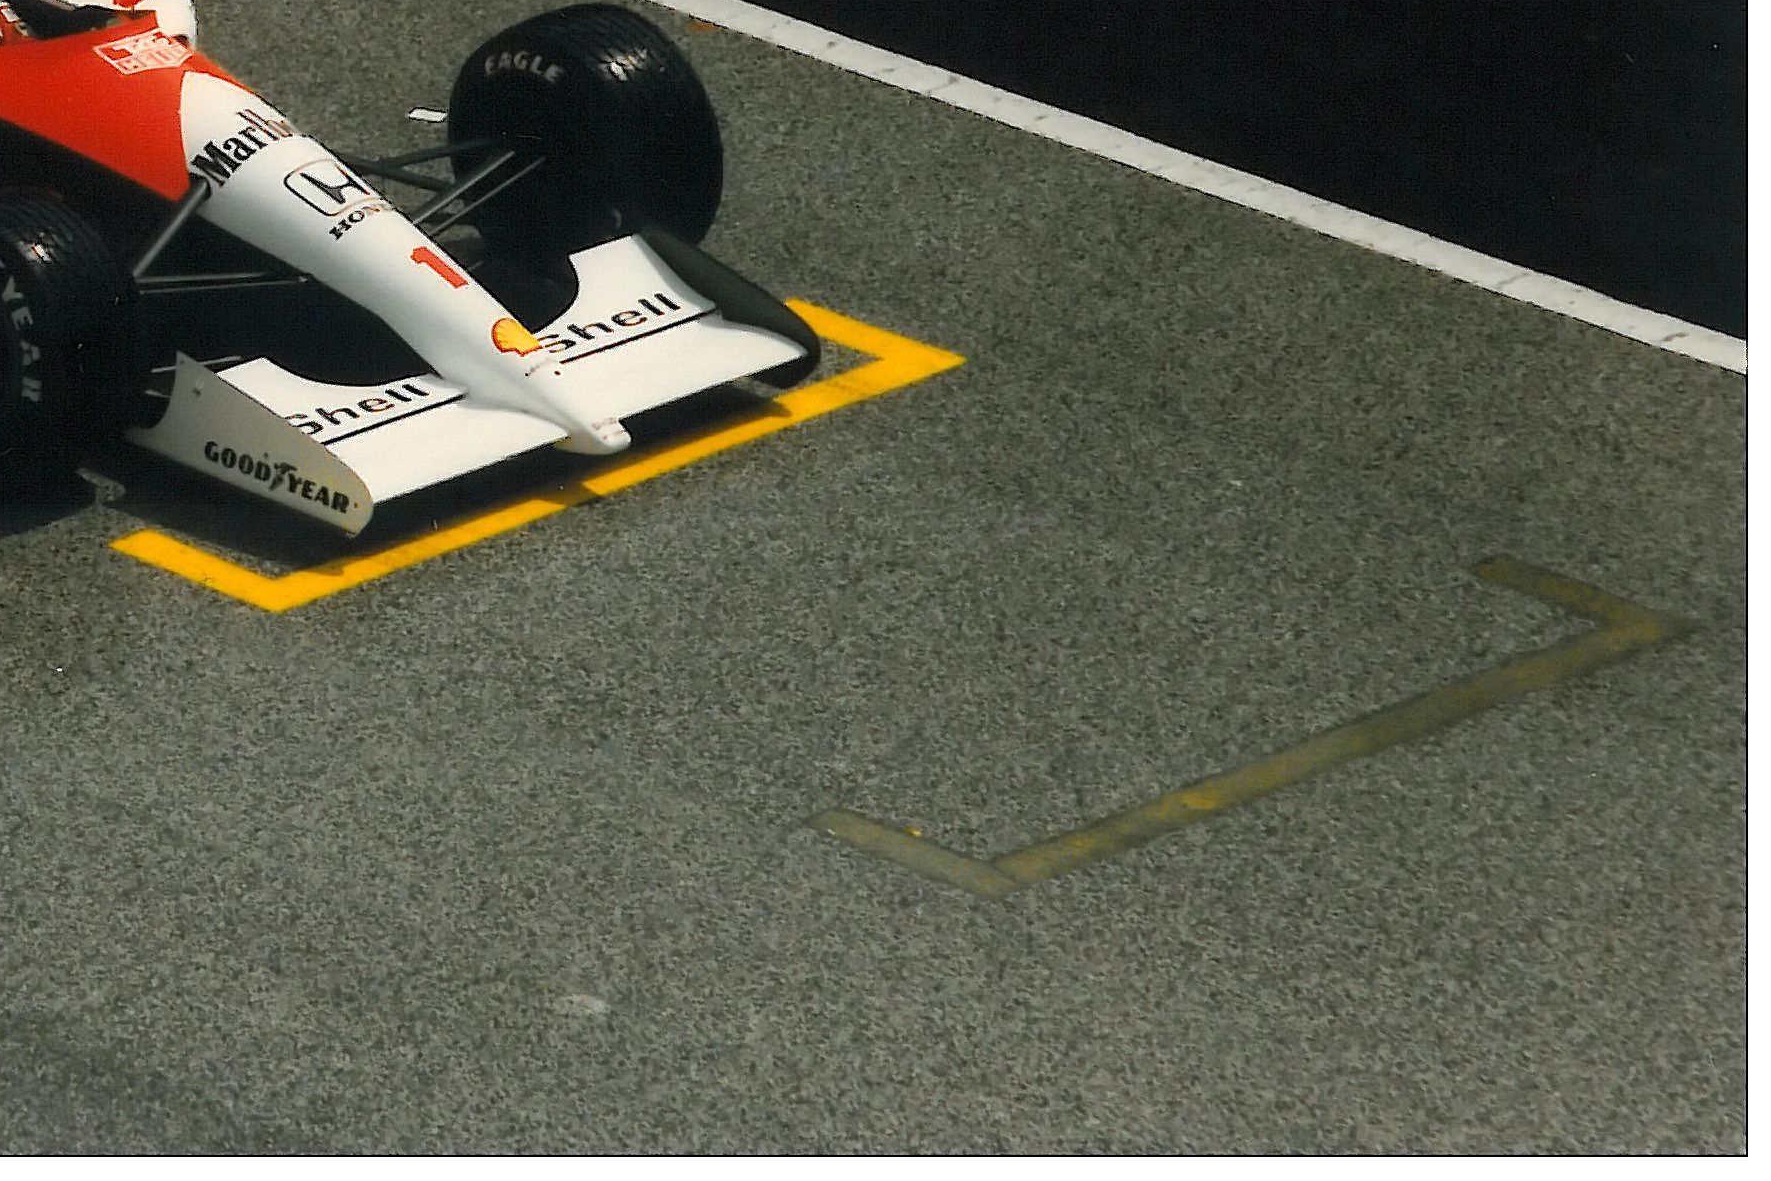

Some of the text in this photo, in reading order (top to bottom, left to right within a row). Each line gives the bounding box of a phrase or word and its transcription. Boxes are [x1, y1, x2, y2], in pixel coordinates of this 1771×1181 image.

[484, 50, 565, 84] EAGLE
[410, 245, 469, 290] 1
[535, 291, 682, 355] Shell
